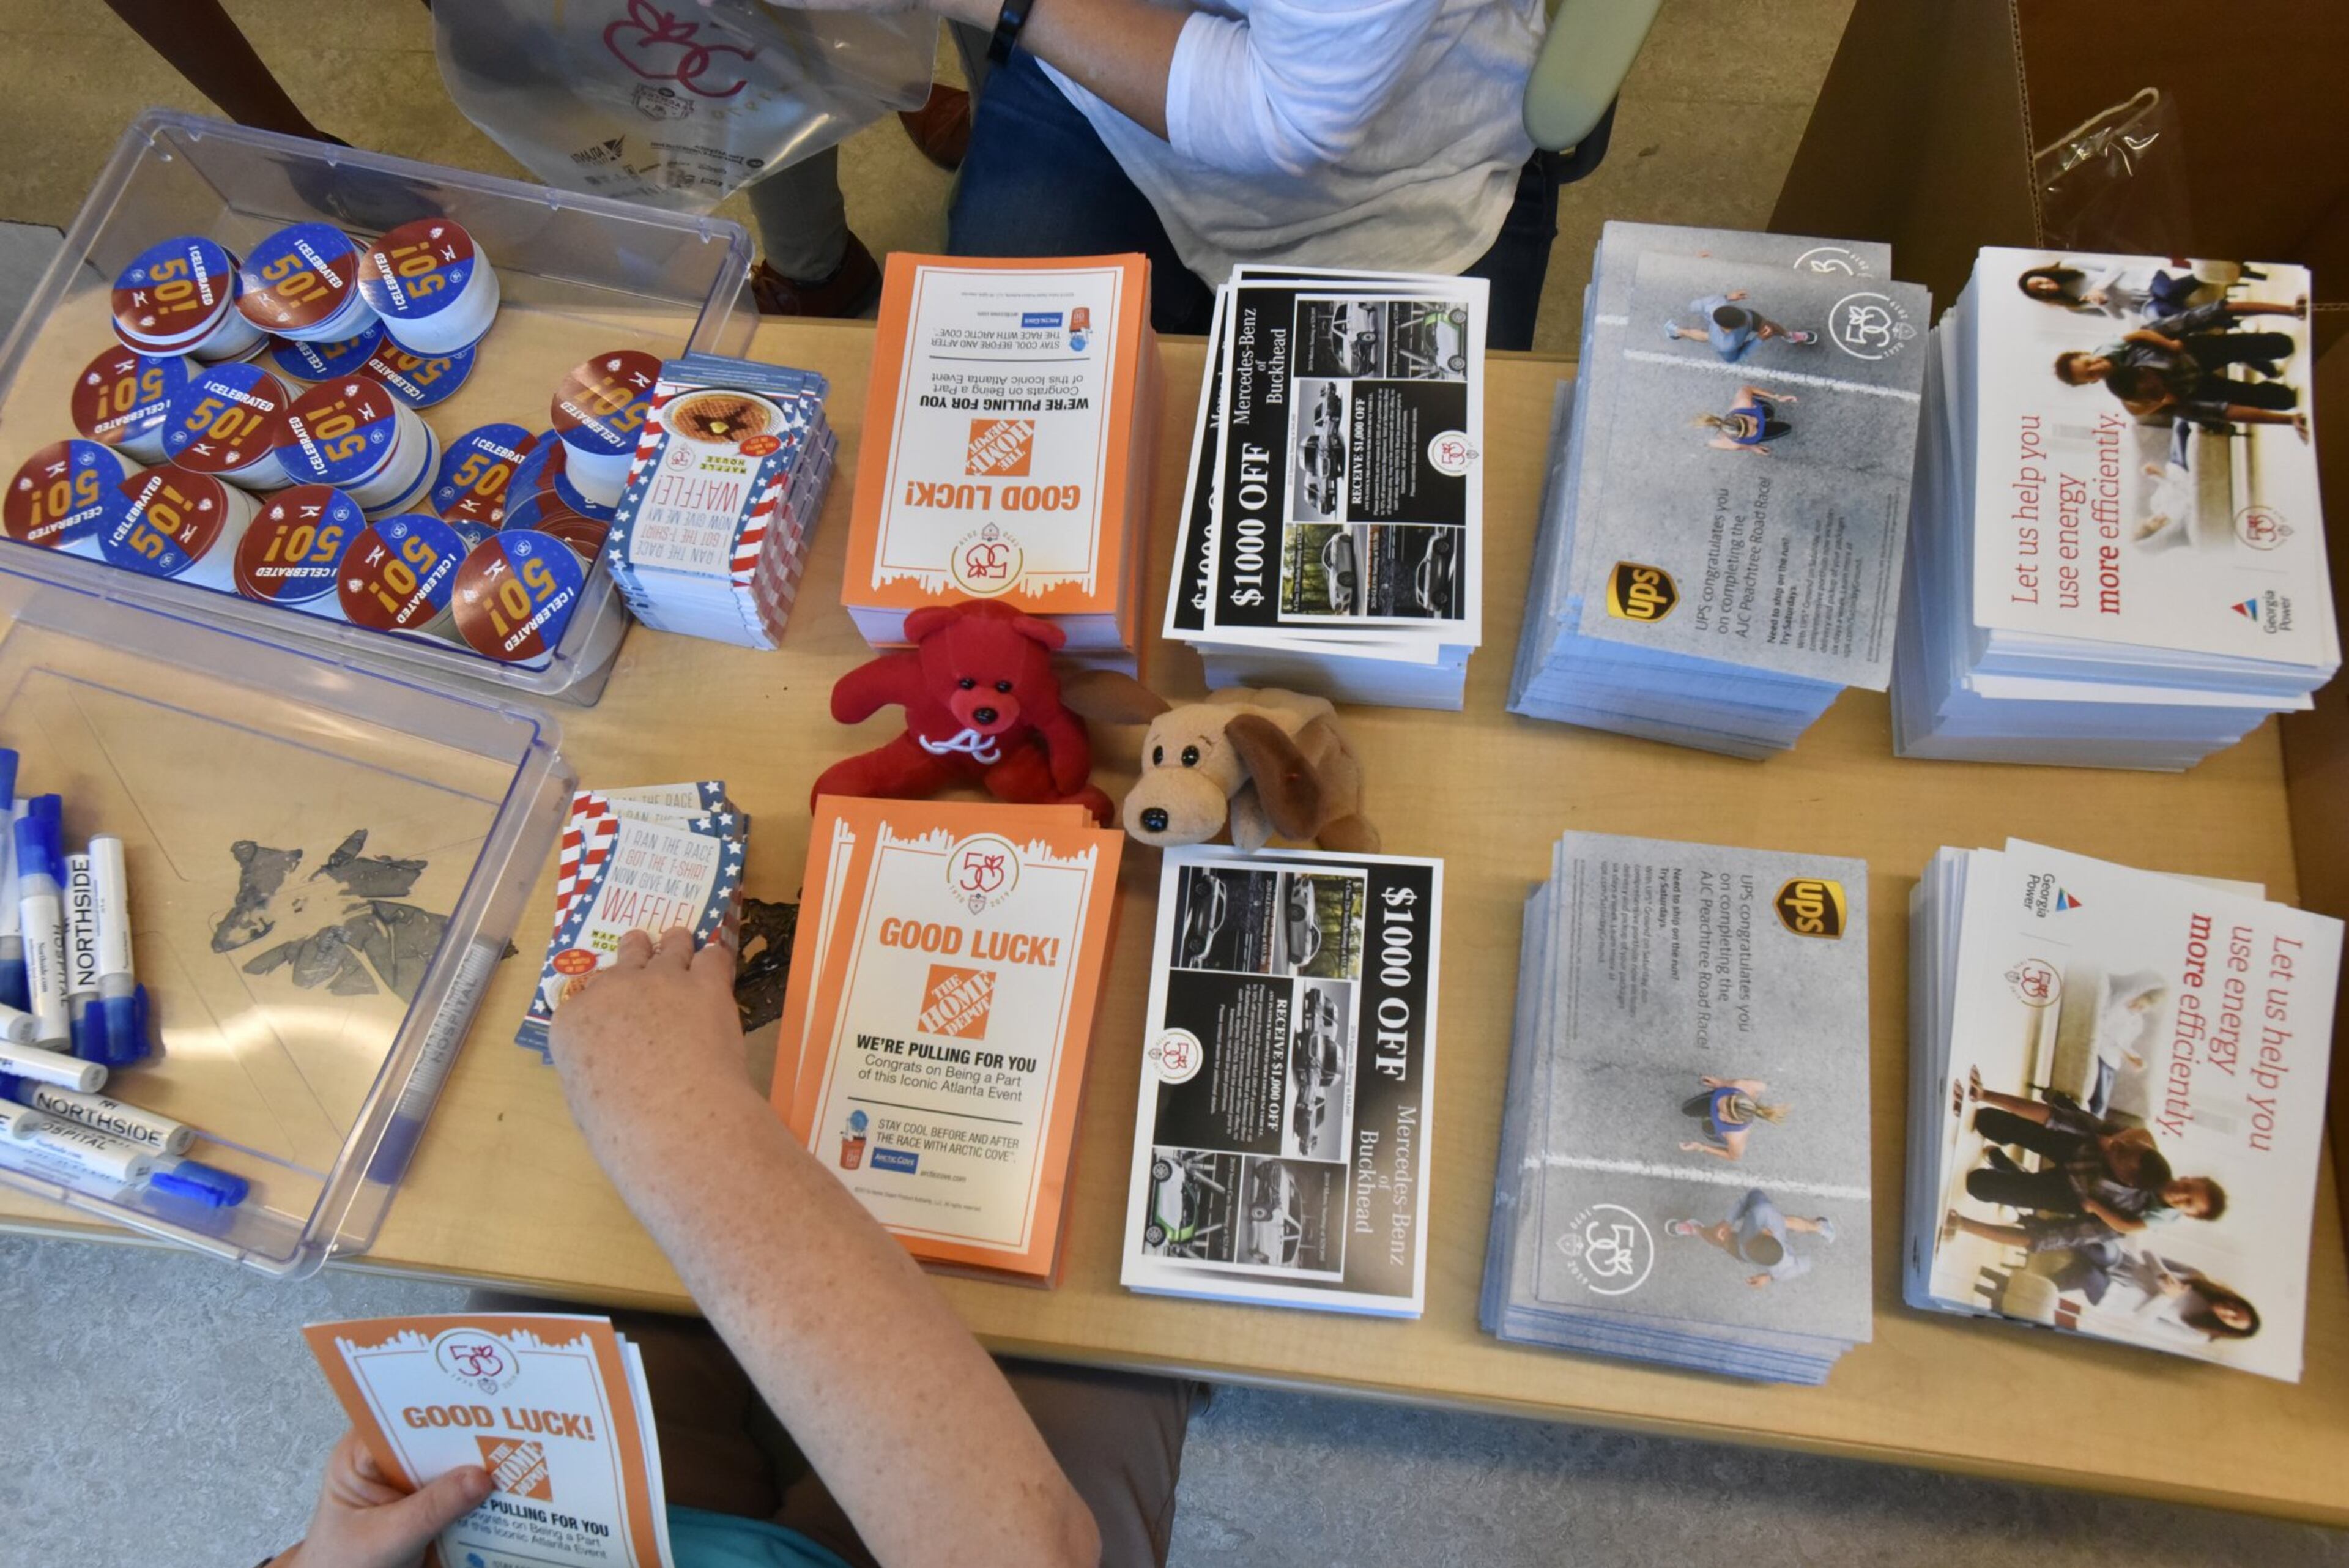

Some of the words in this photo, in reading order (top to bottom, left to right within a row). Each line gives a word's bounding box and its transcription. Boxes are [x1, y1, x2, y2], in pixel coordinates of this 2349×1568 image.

[150, 261, 198, 314] 50!
[190, 252, 213, 306] CELEBRATED
[374, 252, 405, 305] CELEBRATED
[391, 242, 446, 300] 50!
[1234, 308, 1258, 424] Mercedes-Benz
[1255, 359, 1266, 371] of
[1266, 328, 1286, 404] Buckhead
[209, 383, 275, 412] CELEBRATED
[919, 395, 948, 407] YOU
[951, 397, 978, 409] FOR
[982, 398, 1041, 410] PULLING
[1044, 397, 1089, 411] WE'RE
[185, 399, 263, 447] 50!
[2021, 414, 2046, 461] you
[651, 474, 739, 512] WAFFLE!
[1238, 442, 1271, 510] OFF
[1756, 476, 1770, 508] Race!
[2013, 465, 2046, 521] help
[2090, 411, 2129, 540] efficiently.
[111, 475, 163, 540] CELEBRATED
[904, 481, 992, 509] LUCK!
[1000, 483, 1081, 511] GOOD
[1716, 488, 1730, 512] you
[128, 483, 195, 559] 50!
[640, 524, 677, 541] T-SHIRT
[647, 507, 662, 521] MY
[666, 511, 681, 524] ME
[684, 512, 706, 527] GIVE
[708, 515, 732, 530] NOW
[1730, 514, 1745, 536] the
[1751, 510, 1766, 544] Road
[2058, 472, 2087, 561] energy
[635, 541, 665, 558] RACE
[668, 545, 686, 560] THE
[680, 529, 697, 544] THE
[700, 531, 719, 546] GOT
[2022, 527, 2038, 557] us
[691, 548, 714, 564] RAN
[1230, 517, 1269, 607] $1000
[1701, 513, 1727, 603] congratulates
[1626, 567, 1671, 621] ups
[1719, 538, 1743, 614] completing
[1741, 545, 1761, 611] Peachtree
[2012, 563, 2038, 605] Let
[2061, 565, 2079, 609] use
[2098, 544, 2121, 615] more
[481, 557, 557, 638] 50!
[2262, 589, 2280, 634] Georgia
[2278, 595, 2292, 631] Power
[503, 590, 570, 653] CELEBRATED
[1696, 603, 1712, 631] UPS
[1718, 615, 1730, 634] on
[1738, 612, 1752, 639] AJC
[634, 831, 659, 848] RAN
[662, 836, 681, 854] THE
[685, 841, 714, 861] RACE
[612, 866, 637, 885] NOW
[639, 872, 662, 891] GIVE
[664, 879, 681, 896] ME
[683, 884, 702, 901] MY
[626, 849, 646, 866] GOT
[650, 854, 667, 871] THE
[669, 858, 708, 881] T-SHIRT
[1659, 866, 1668, 880] Try
[1672, 868, 1681, 892] Need
[1699, 870, 1712, 895] AJC
[1720, 872, 1731, 891] on
[1672, 894, 1680, 904] to
[1739, 874, 1753, 901] UPS
[2022, 873, 2039, 910] Power
[2033, 871, 2055, 920] Georgia
[72, 860, 95, 986] NORTHSIDE
[1671, 906, 1680, 926] ship
[1784, 881, 1823, 933] ups
[877, 916, 965, 956] GOOD
[970, 929, 1060, 968] LUCK!
[1375, 886, 1417, 987] $1000
[1671, 927, 1679, 939] on
[1697, 899, 1712, 968] Peachtree
[1716, 894, 1732, 975] completing
[2182, 912, 2214, 990] more
[2227, 924, 2252, 973] use
[1670, 959, 1679, 980] run?
[1735, 903, 1752, 1001] congratulates
[2268, 934, 2303, 984] Let
[918, 970, 997, 1035] HOME
[931, 973, 963, 998] THE
[1697, 972, 1710, 1008] Road
[1718, 978, 1731, 1001] the
[2263, 986, 2288, 1022] us
[944, 997, 992, 1037] DEPOT
[1271, 998, 1287, 1060] RECEIVE
[1696, 1011, 1710, 1049] Race!
[1735, 1004, 1749, 1032] you
[2206, 974, 2247, 1077] energy
[855, 1034, 905, 1055] WE'RE
[907, 1042, 972, 1065] PULLING
[974, 1051, 1004, 1068] FOR
[1007, 1055, 1037, 1073] YOU
[1375, 996, 1409, 1081] OFF
[863, 1053, 924, 1075] Congrats
[925, 1065, 942, 1076] on
[944, 1066, 982, 1084] Being
[983, 1074, 992, 1083] a
[995, 1072, 1022, 1088] Part
[2154, 990, 2208, 1142] efficiently.
[2249, 1024, 2292, 1092] help
[857, 1068, 874, 1082] of
[874, 1070, 897, 1084] this
[899, 1074, 938, 1090] Iconic
[940, 1079, 985, 1097] Atlanta
[987, 1086, 1022, 1102] Event
[1267, 1062, 1283, 1101] $1,000
[36, 1093, 163, 1147] NORTHSIDE
[878, 1118, 901, 1132] STAY
[903, 1123, 929, 1136] COOL
[930, 1126, 968, 1142] BEFORE
[968, 1132, 989, 1145] AND
[989, 1135, 1019, 1149] AFTER
[1266, 1103, 1279, 1131] OFF
[2241, 1092, 2277, 1153] you
[41, 1122, 107, 1150] OSPITAL
[875, 1131, 894, 1144] THE
[896, 1134, 919, 1148] RACE
[921, 1139, 946, 1152] WITH
[948, 1142, 982, 1157] ARCTIC
[1353, 1129, 1378, 1234] Buckhead
[1377, 1175, 1391, 1190] of
[1389, 1105, 1416, 1266] Mercedes-Benz
[403, 1405, 495, 1429] GOOD
[505, 1406, 596, 1441] LUCK!
[491, 1499, 548, 1524] PULLING
[551, 1512, 579, 1529] FOR
[582, 1520, 609, 1537] YOU
